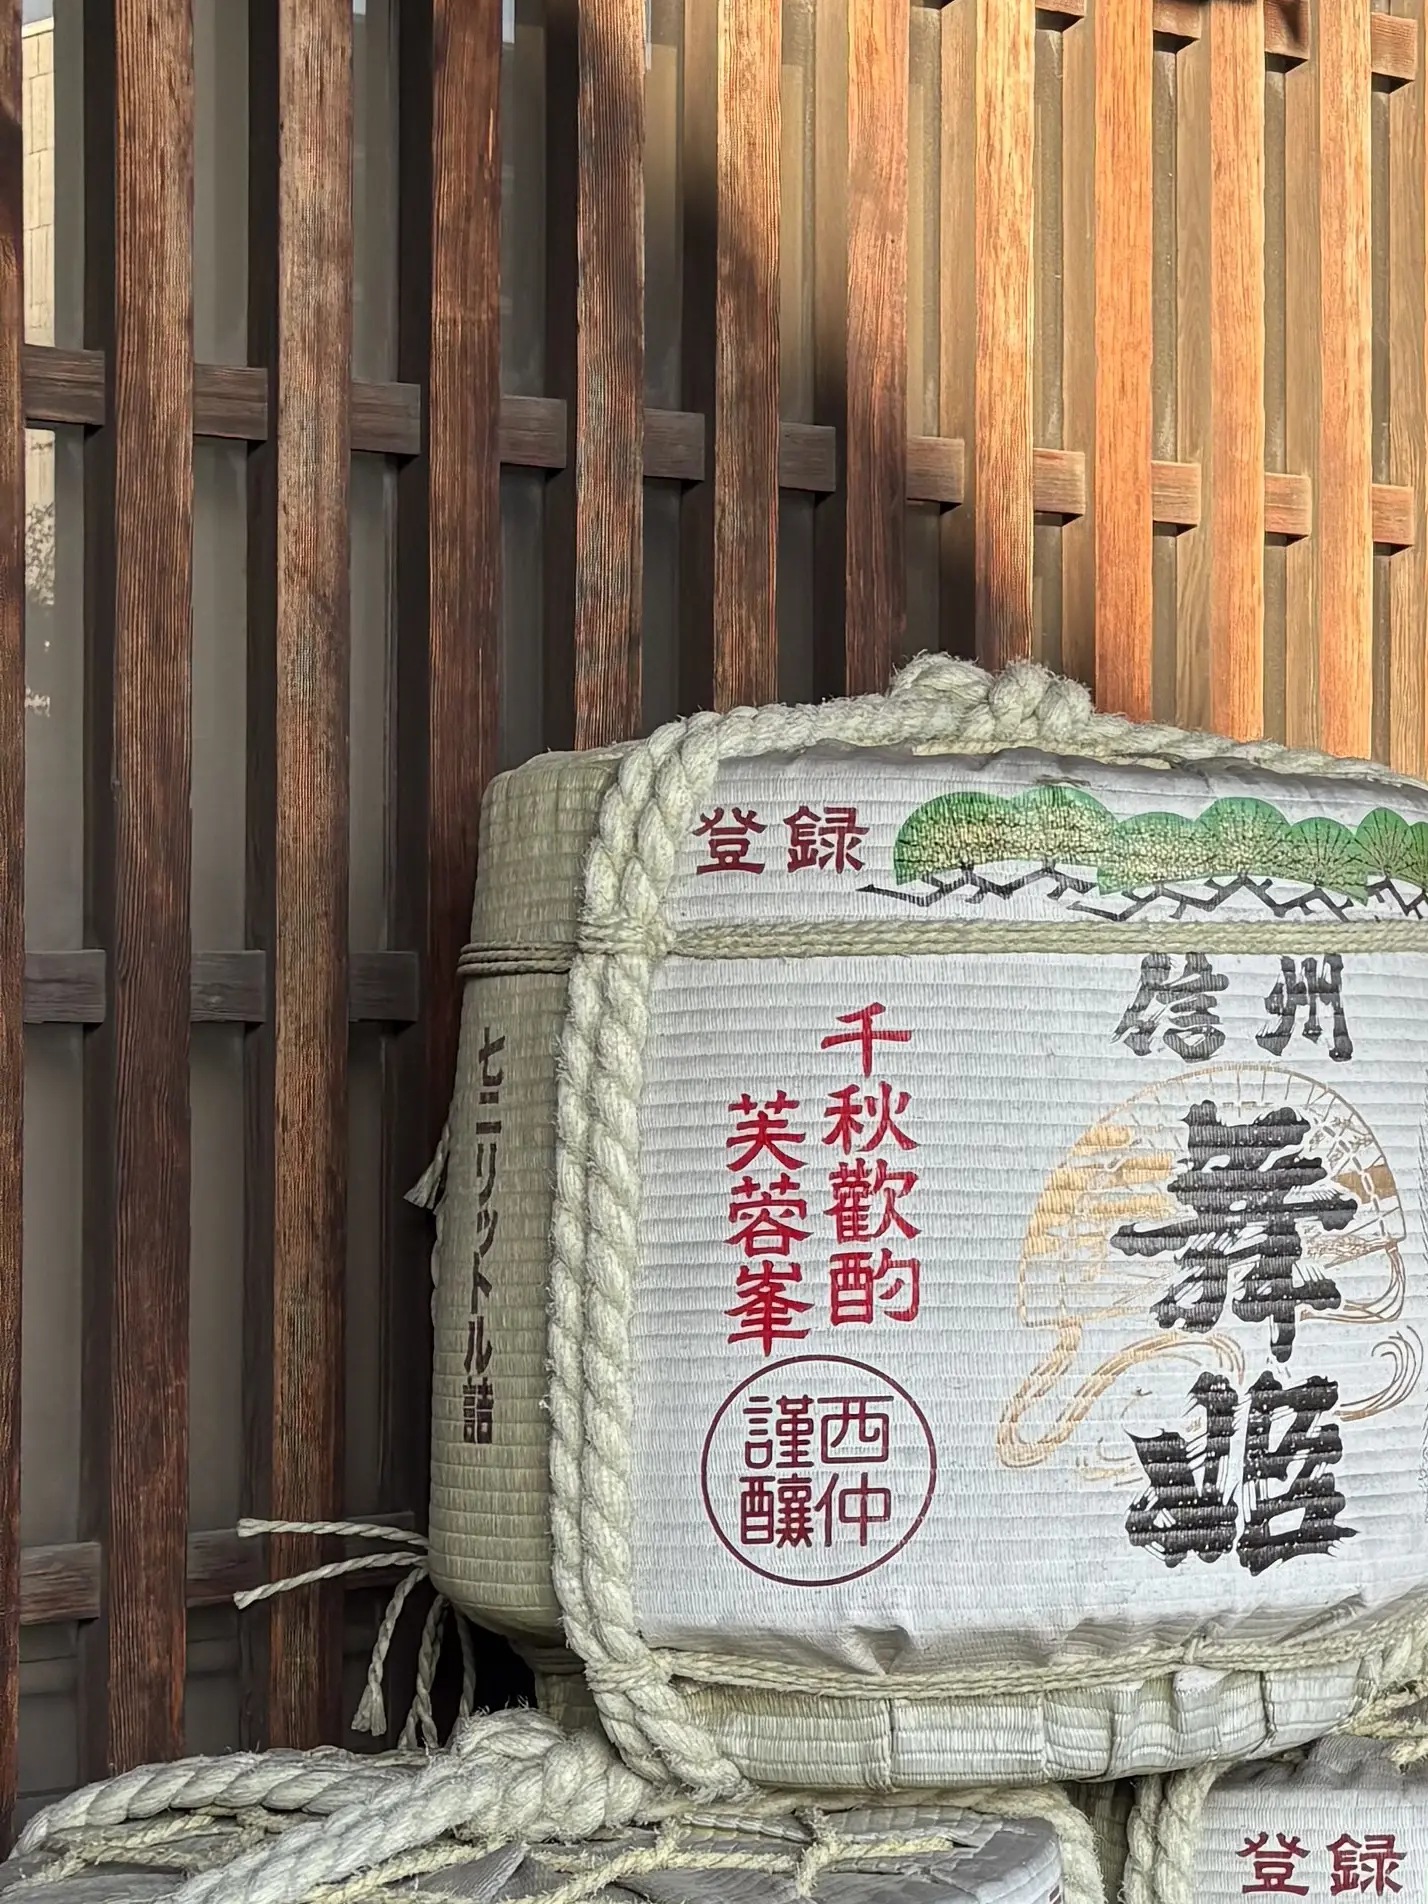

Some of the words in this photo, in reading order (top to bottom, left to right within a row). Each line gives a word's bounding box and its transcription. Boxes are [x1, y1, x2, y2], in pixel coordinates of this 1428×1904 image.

[693, 805, 870, 875] 登録
[1111, 952, 1353, 1063] 信州
[1236, 1830, 1402, 1898] 登録
